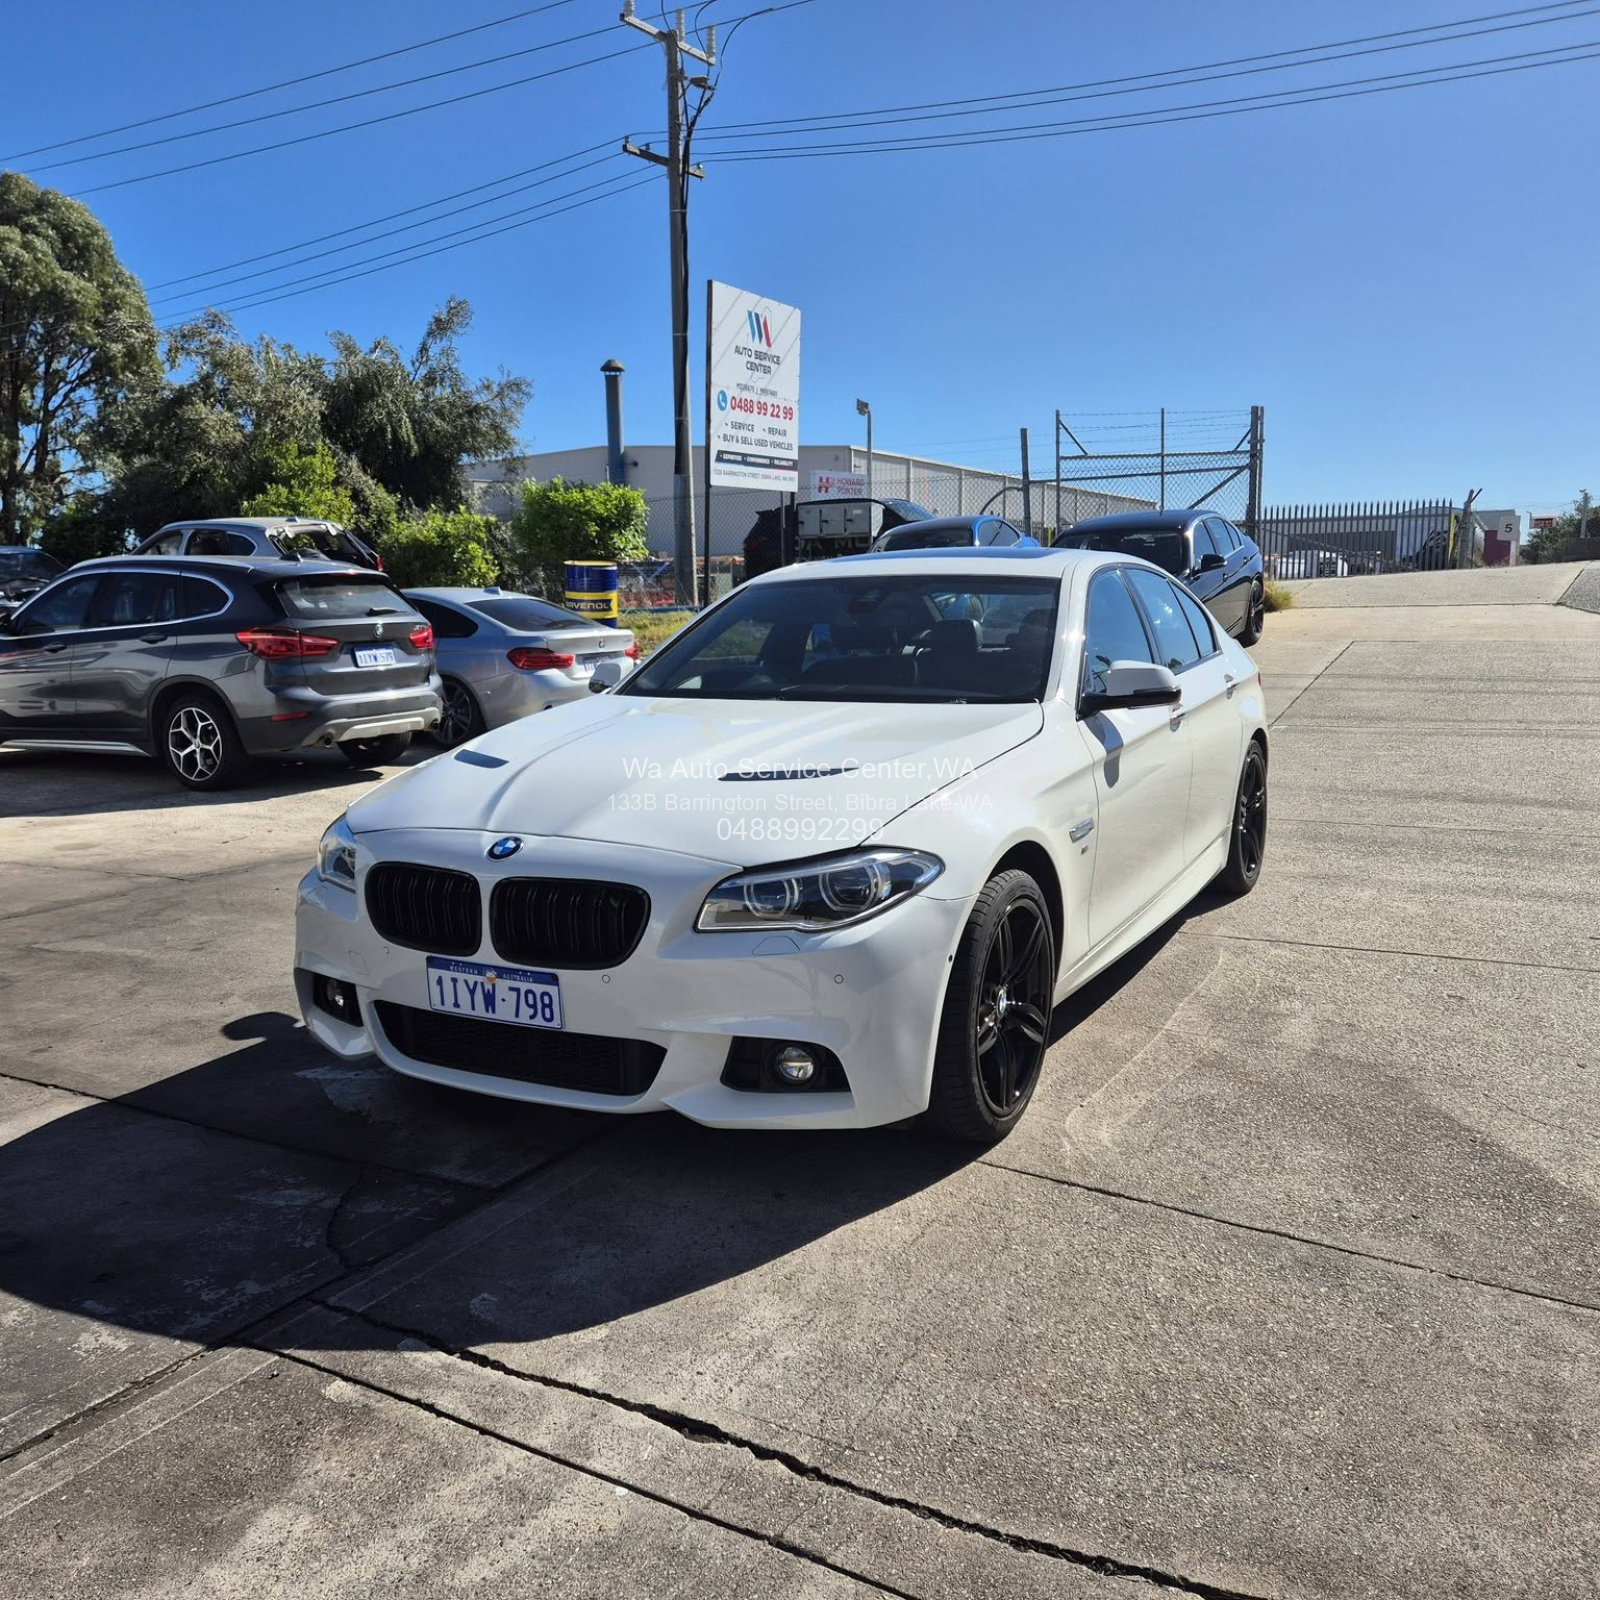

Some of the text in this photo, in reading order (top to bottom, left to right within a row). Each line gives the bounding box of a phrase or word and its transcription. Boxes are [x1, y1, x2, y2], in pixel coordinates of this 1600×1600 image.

[734, 345, 781, 365] AUTO SERVICE
[746, 360, 772, 375] CENTER
[730, 396, 793, 421] 0488 99 22 99
[730, 421, 787, 437] SERVICE REPAIR
[723, 433, 735, 443] BUY
[741, 436, 753, 446] SELL
[754, 438, 768, 447] USED
[769, 440, 793, 451] VEHICLES
[837, 477, 865, 486] HOWARD
[1504, 523, 1513, 533] 5
[450, 965, 534, 982] WESTERN AUSTRALIA
